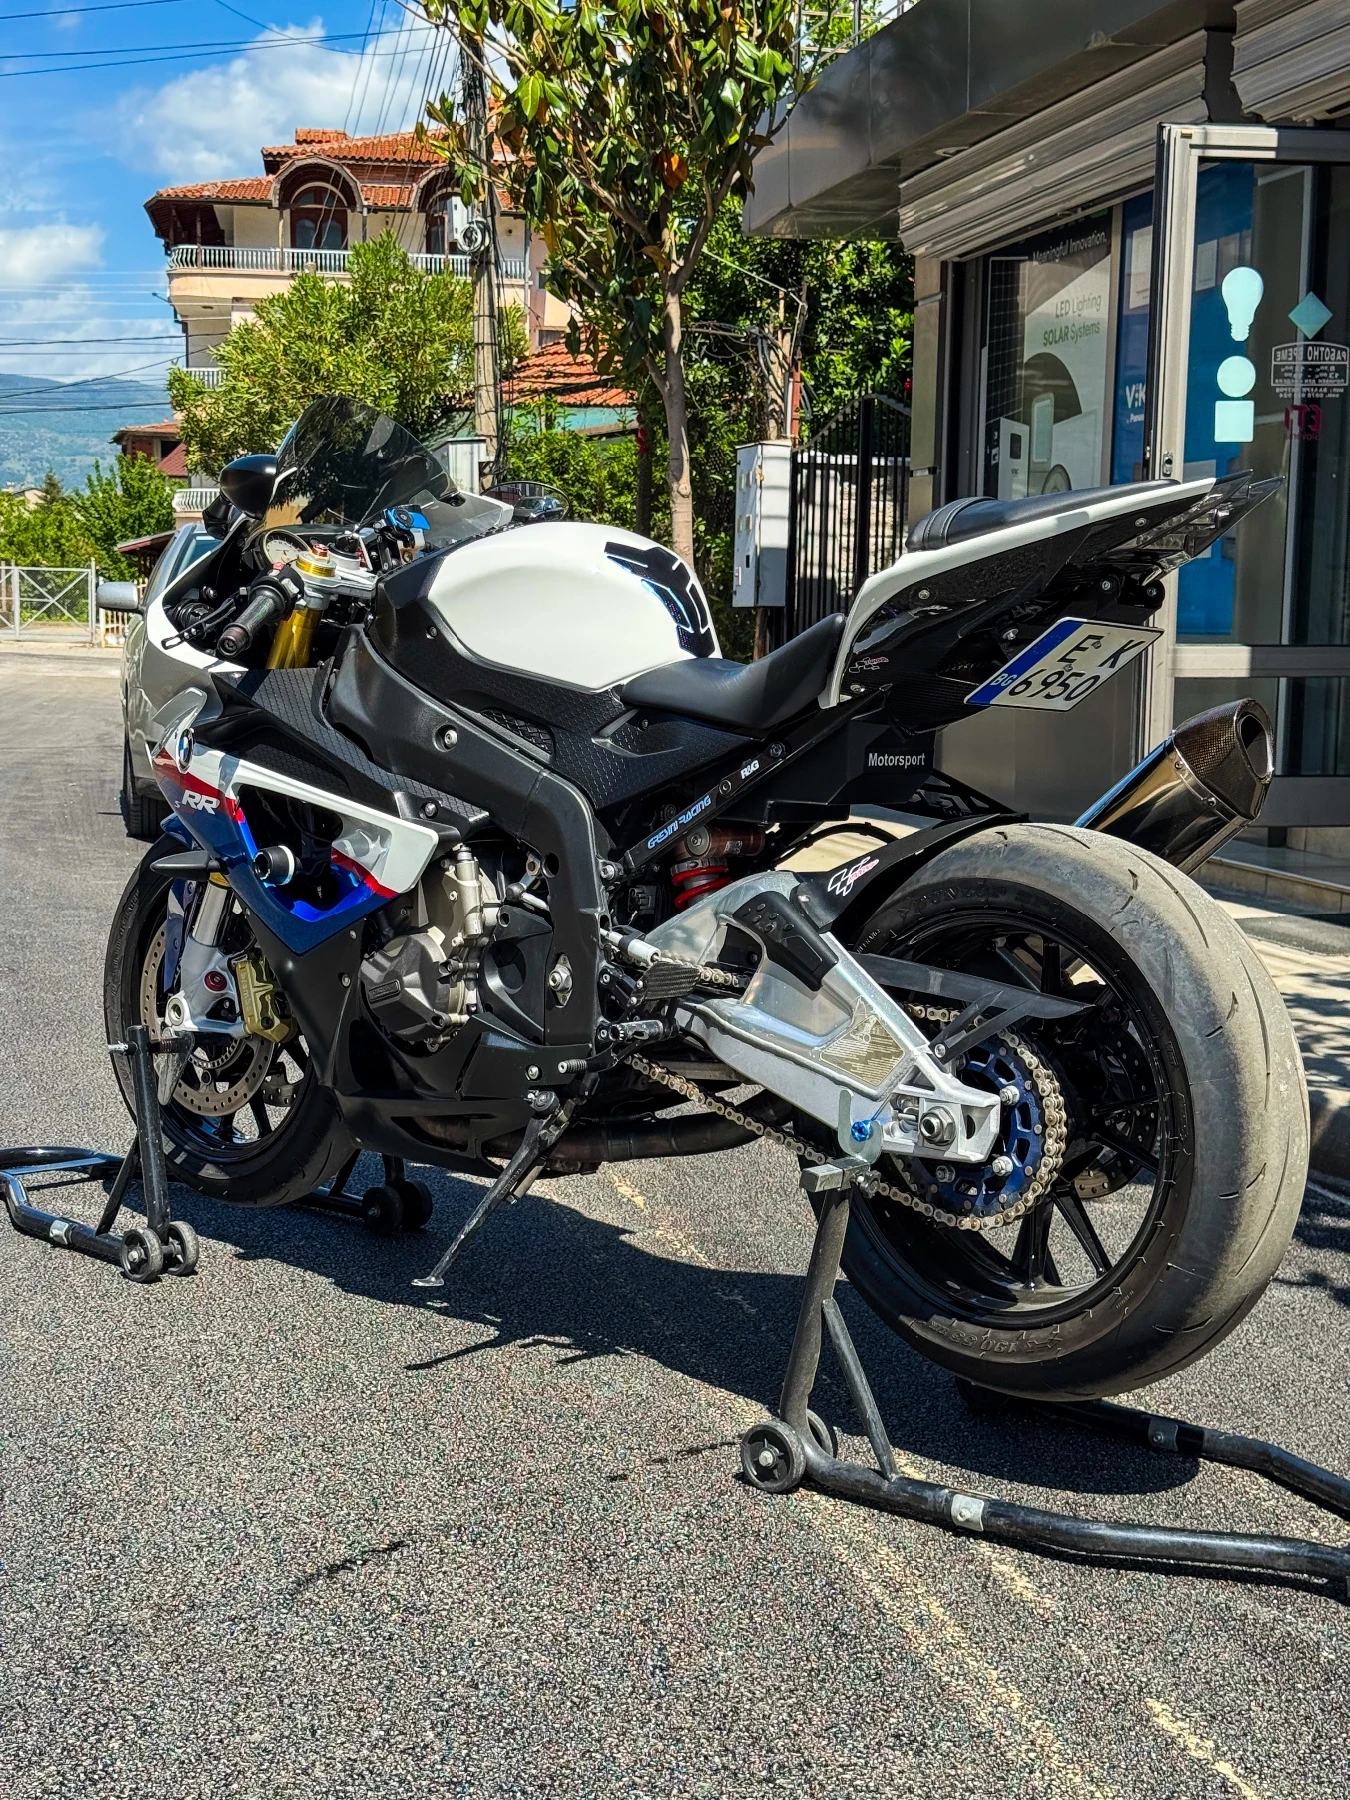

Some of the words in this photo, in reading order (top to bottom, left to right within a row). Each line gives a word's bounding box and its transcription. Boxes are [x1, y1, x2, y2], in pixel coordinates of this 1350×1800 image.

[1032, 238, 1069, 267] Meaningful
[1069, 230, 1107, 254] Innovation.
[1055, 300, 1070, 319] LED
[1071, 294, 1102, 317] Lighting
[1043, 325, 1069, 347] SOLAR
[1070, 321, 1101, 345] Systems
[1056, 634, 1106, 663] E
[1097, 639, 1147, 669] K
[990, 673, 1017, 687] BG
[1008, 669, 1101, 702] 6950
[740, 759, 760, 780] R&G
[868, 752, 926, 769] Motorsport
[181, 789, 221, 815] RR
[677, 794, 712, 824] RACING
